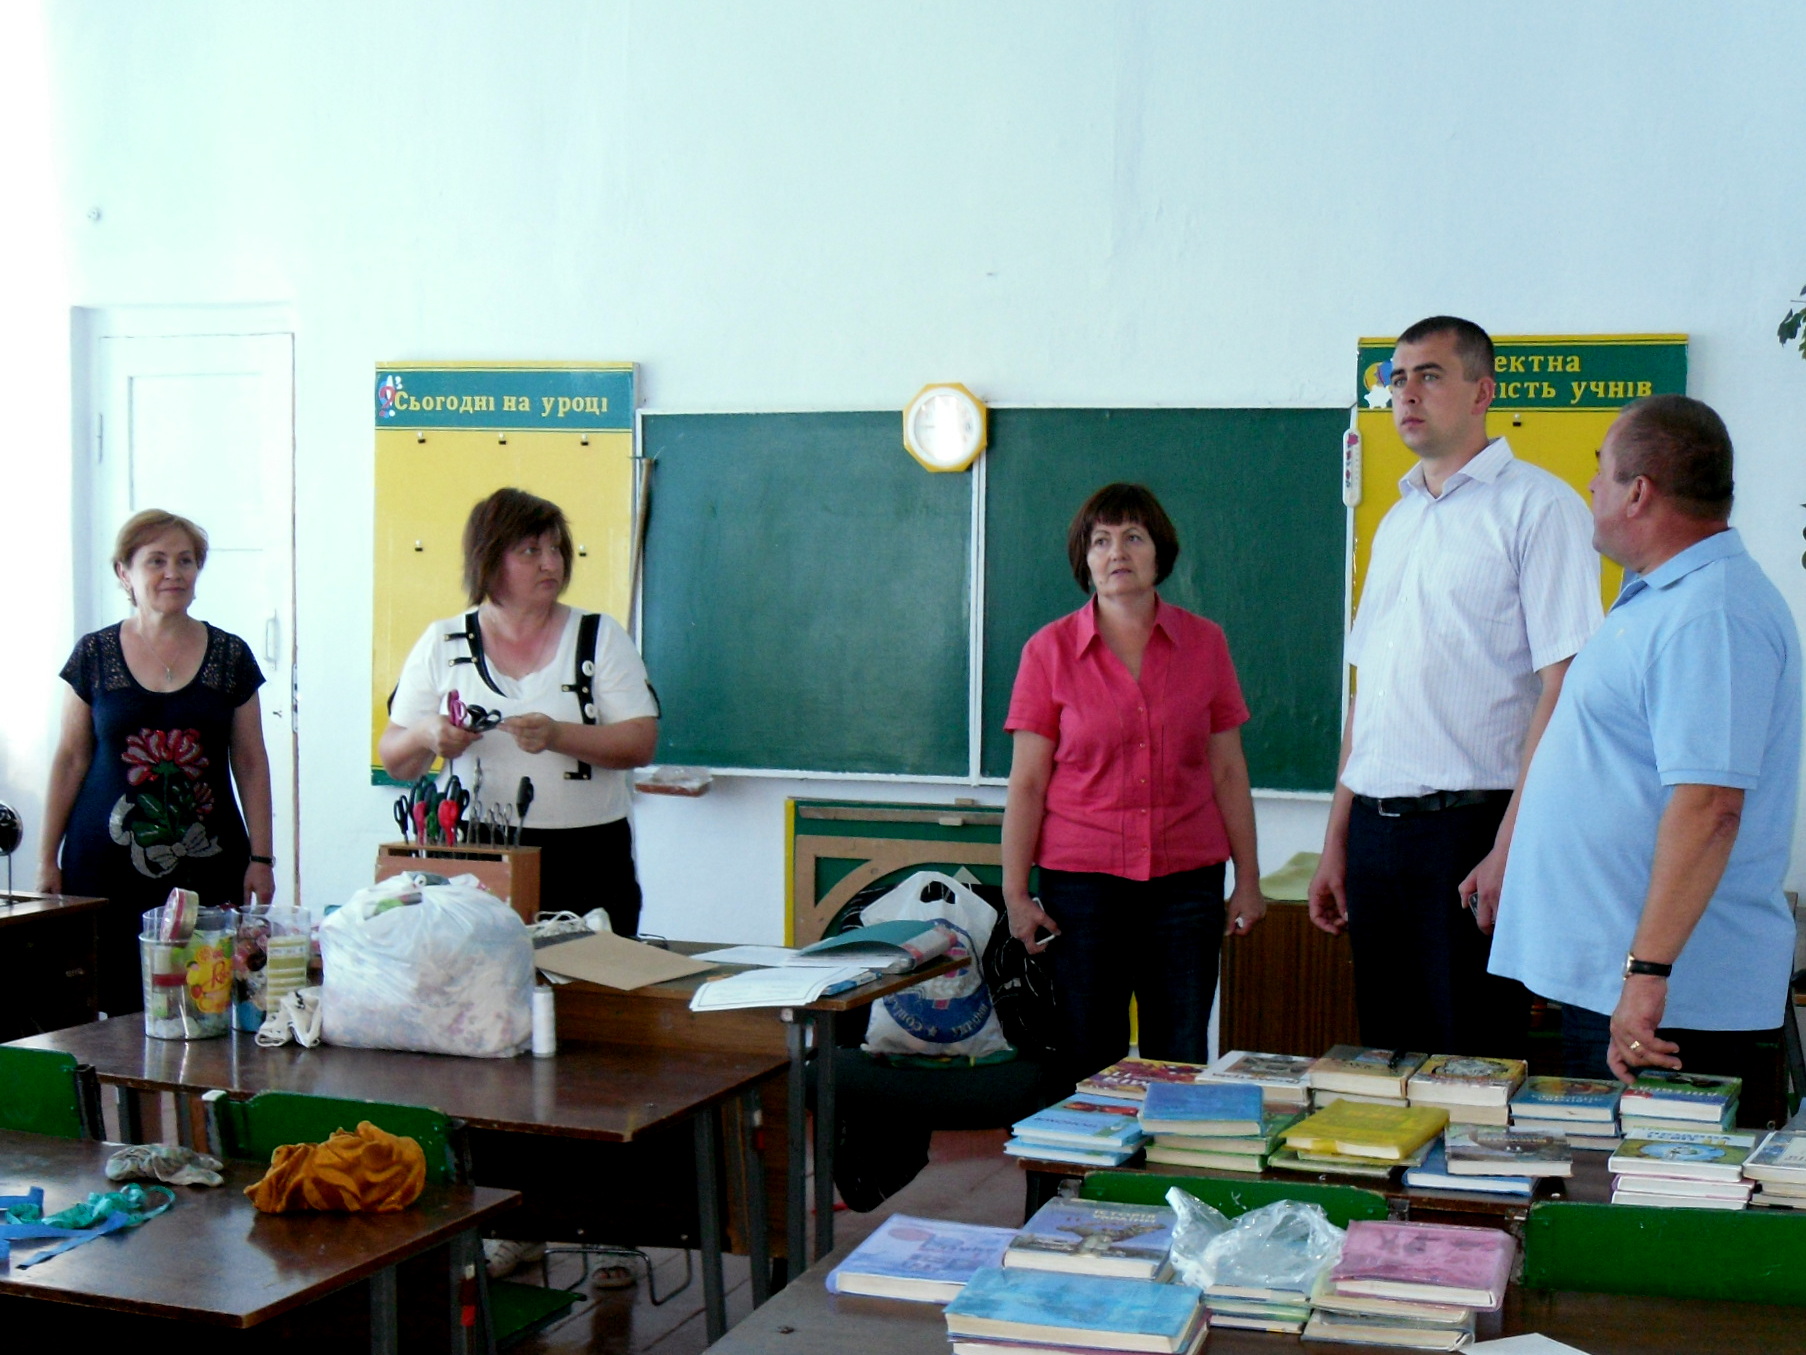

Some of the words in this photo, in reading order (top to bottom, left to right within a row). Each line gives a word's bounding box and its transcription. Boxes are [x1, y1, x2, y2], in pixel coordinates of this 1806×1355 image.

[1494, 355, 1581, 372] ектна
[394, 391, 495, 413] Сьогодні
[502, 396, 530, 411] на
[541, 396, 608, 417] уроці
[1492, 381, 1556, 398] ість
[1570, 381, 1652, 404] учнів
